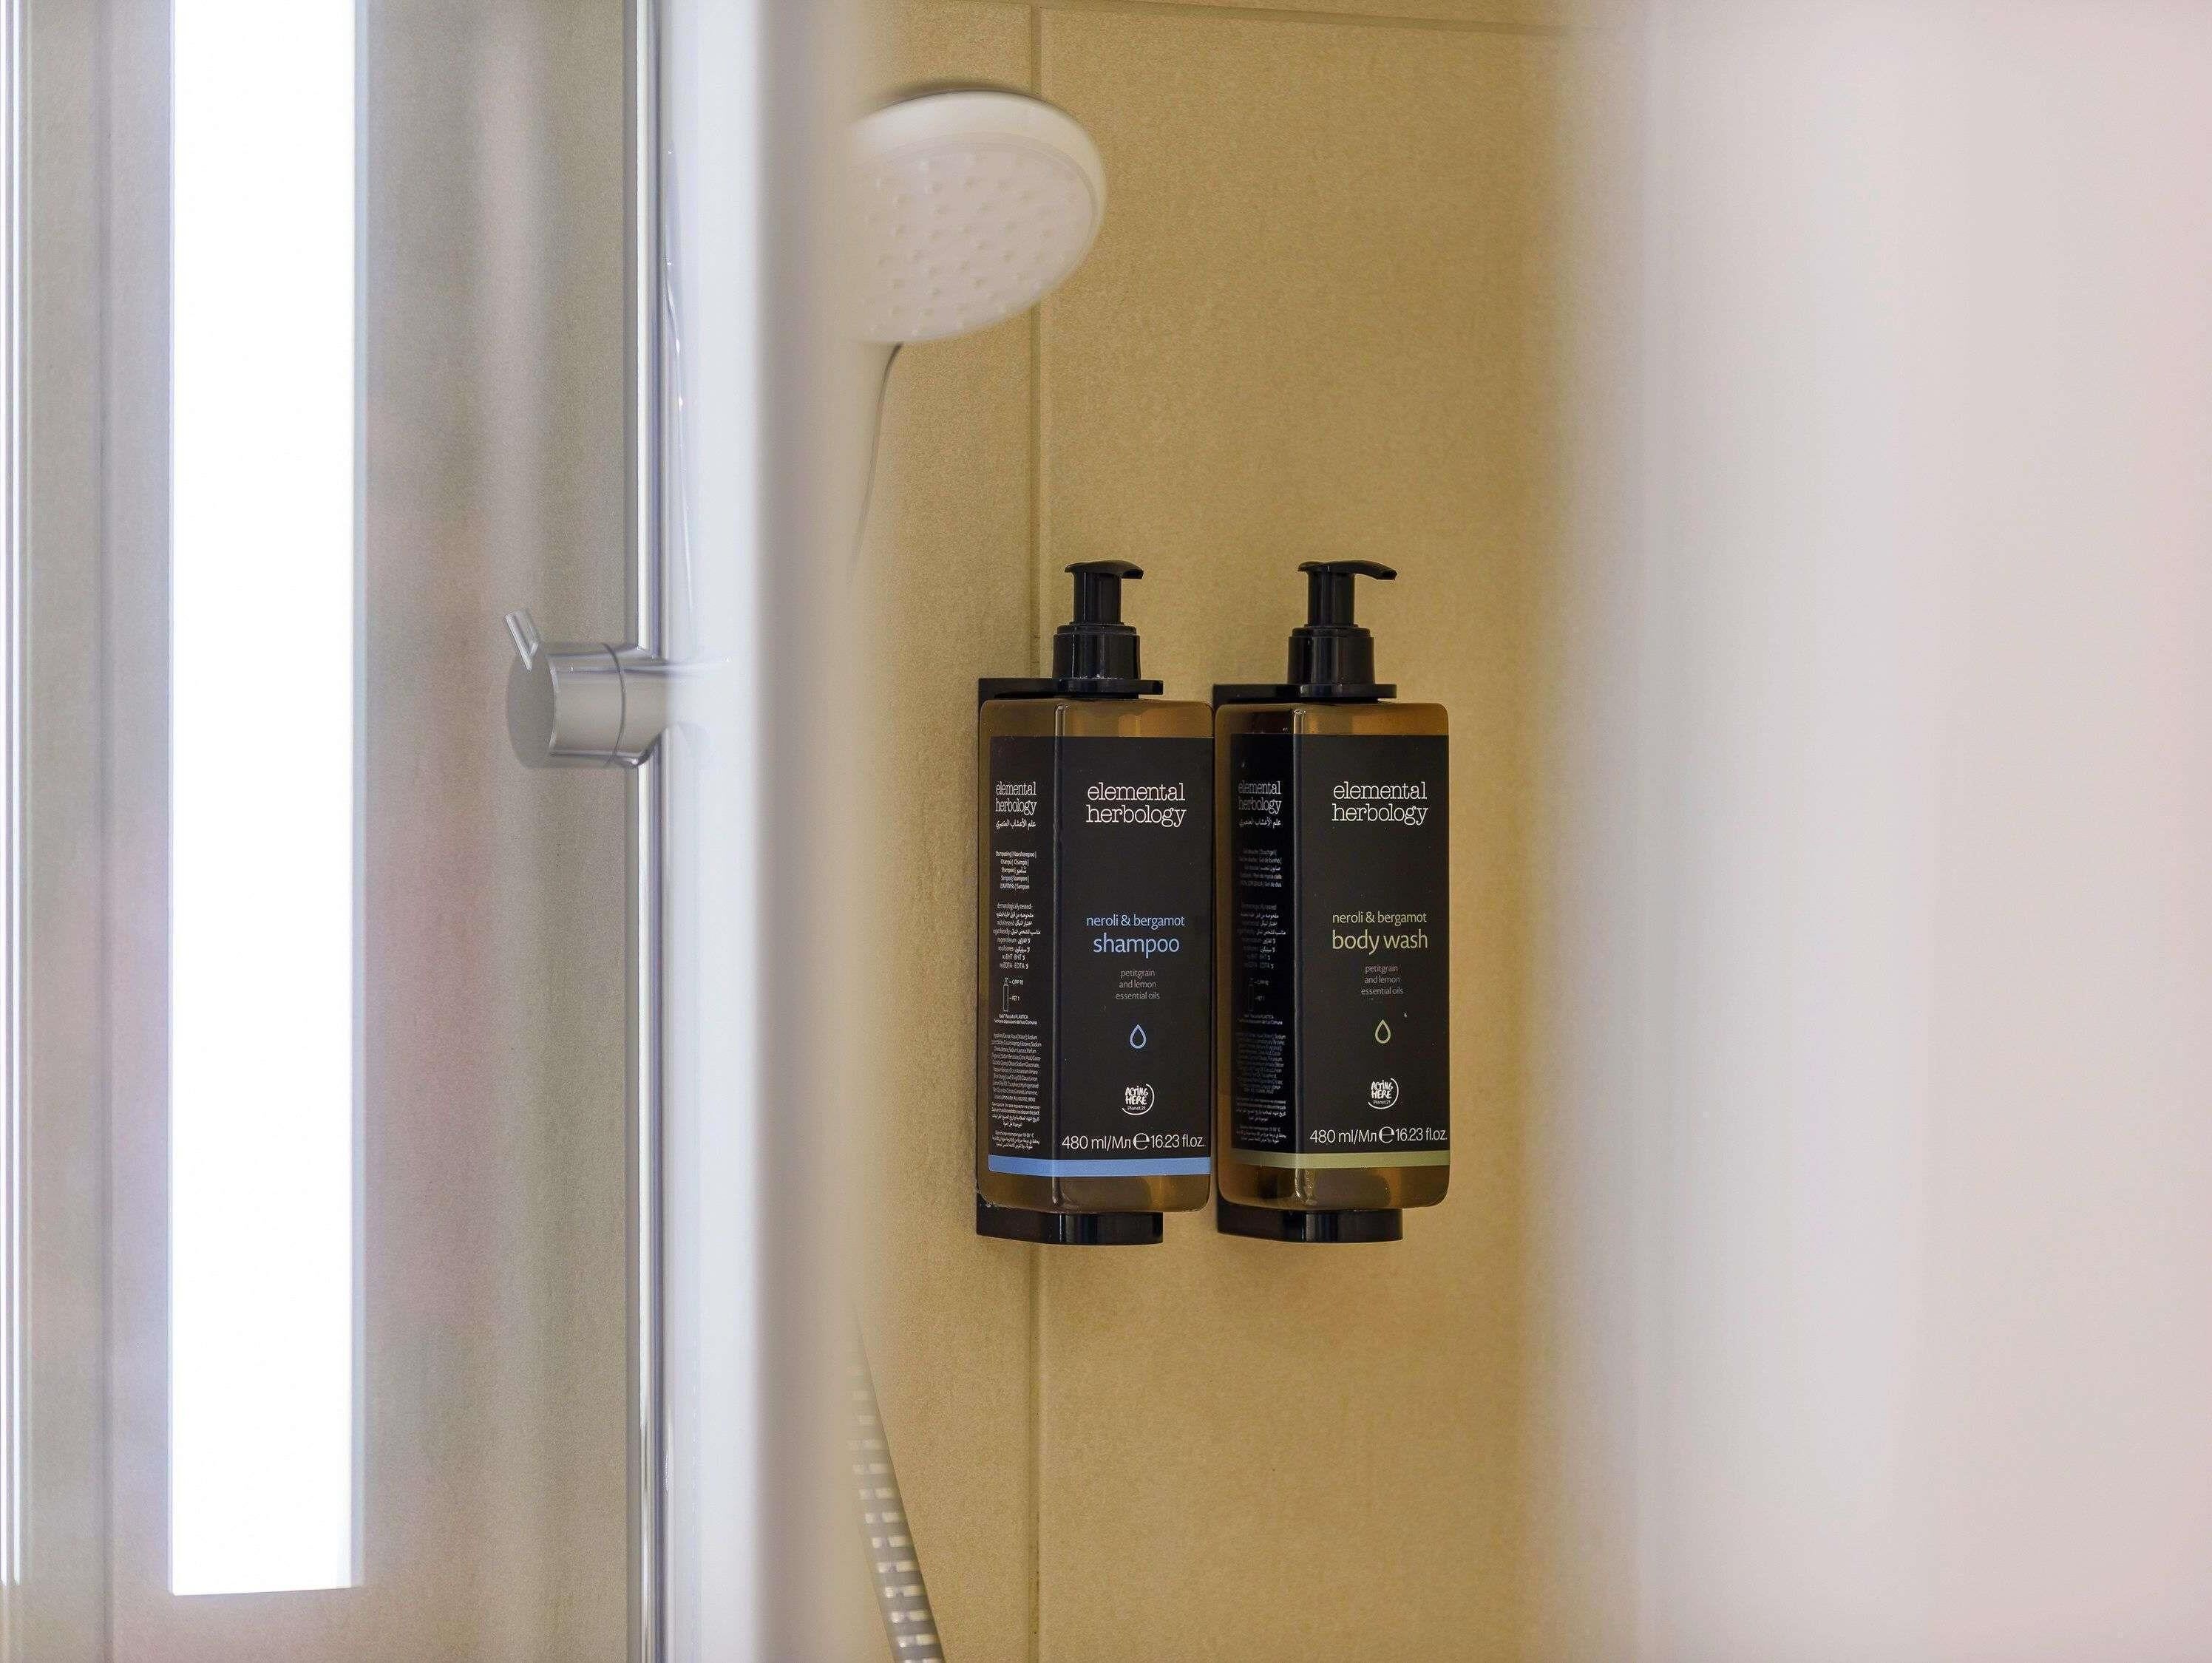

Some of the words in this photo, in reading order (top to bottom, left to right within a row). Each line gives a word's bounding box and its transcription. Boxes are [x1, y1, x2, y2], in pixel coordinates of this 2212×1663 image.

[996, 781, 1037, 795] elemental
[1088, 782, 1185, 800] elemental
[1238, 780, 1281, 795] elemental
[1333, 781, 1427, 800] elemental
[996, 798, 1037, 815] herbology
[1238, 796, 1282, 815] herbology
[1086, 805, 1187, 827] herbology
[1331, 803, 1428, 826] herbology
[1087, 914, 1119, 926] neroli
[1121, 914, 1130, 926] &
[1133, 914, 1185, 930] bergamot
[1332, 911, 1363, 923] neroli
[1365, 911, 1374, 923] &
[1377, 911, 1427, 926] bergamot
[1093, 932, 1180, 959] shampoo
[1332, 929, 1380, 955] body
[1383, 929, 1428, 949] wash
[1121, 969, 1156, 979] petitgrain
[1365, 965, 1398, 974] petitgrain
[1119, 980, 1133, 988] and
[1134, 980, 1156, 988] lemon
[1364, 976, 1377, 984] and
[1378, 976, 1400, 984] lemon
[1116, 991, 1147, 1000] essential
[1148, 991, 1160, 999] oils
[1125, 1096, 1147, 1105] HERE
[1371, 1090, 1391, 1099] HERE
[1062, 1135, 1088, 1149] 480
[1150, 1135, 1180, 1148] 16.23
[1309, 1129, 1335, 1143] 480
[1395, 1128, 1423, 1141] 16.23
